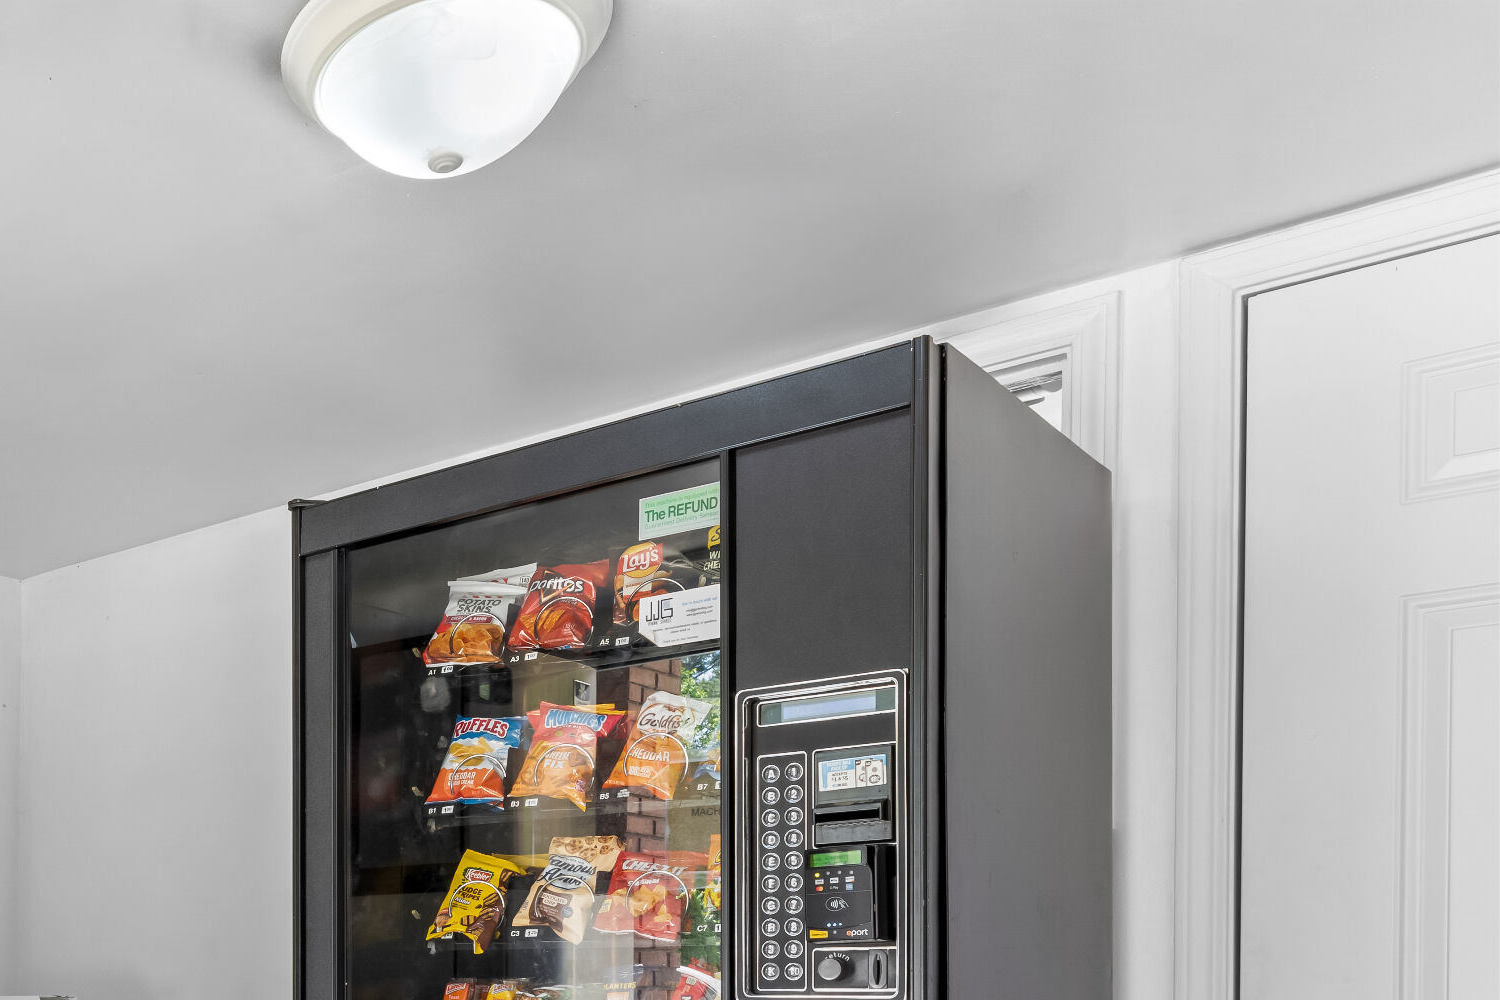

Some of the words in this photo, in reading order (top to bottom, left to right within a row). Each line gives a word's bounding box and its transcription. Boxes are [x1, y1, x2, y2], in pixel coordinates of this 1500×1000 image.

[645, 509, 665, 522] The
[668, 496, 718, 518] REFUND
[622, 547, 659, 573] Lay's
[530, 577, 584, 592] Doritos
[457, 605, 493, 614] SKINS
[646, 597, 674, 622] JJG
[545, 709, 607, 731] MUNCHIES
[453, 717, 509, 738] RUFFLES
[544, 760, 564, 768] FIX
[768, 769, 775, 778] A
[791, 767, 796, 777] 1
[768, 791, 775, 801] B
[791, 789, 798, 799] 2
[768, 813, 775, 823] C
[791, 811, 797, 820] 3
[790, 833, 797, 843] 4
[768, 857, 776, 866] E
[791, 855, 797, 865] 5
[791, 878, 797, 887] 6
[455, 889, 481, 901] TRIPES
[768, 900, 776, 910] G
[791, 921, 797, 932] 8
[846, 929, 868, 937] eport
[791, 944, 797, 954] 9
[768, 967, 775, 976] K
[789, 966, 800, 976] 10
